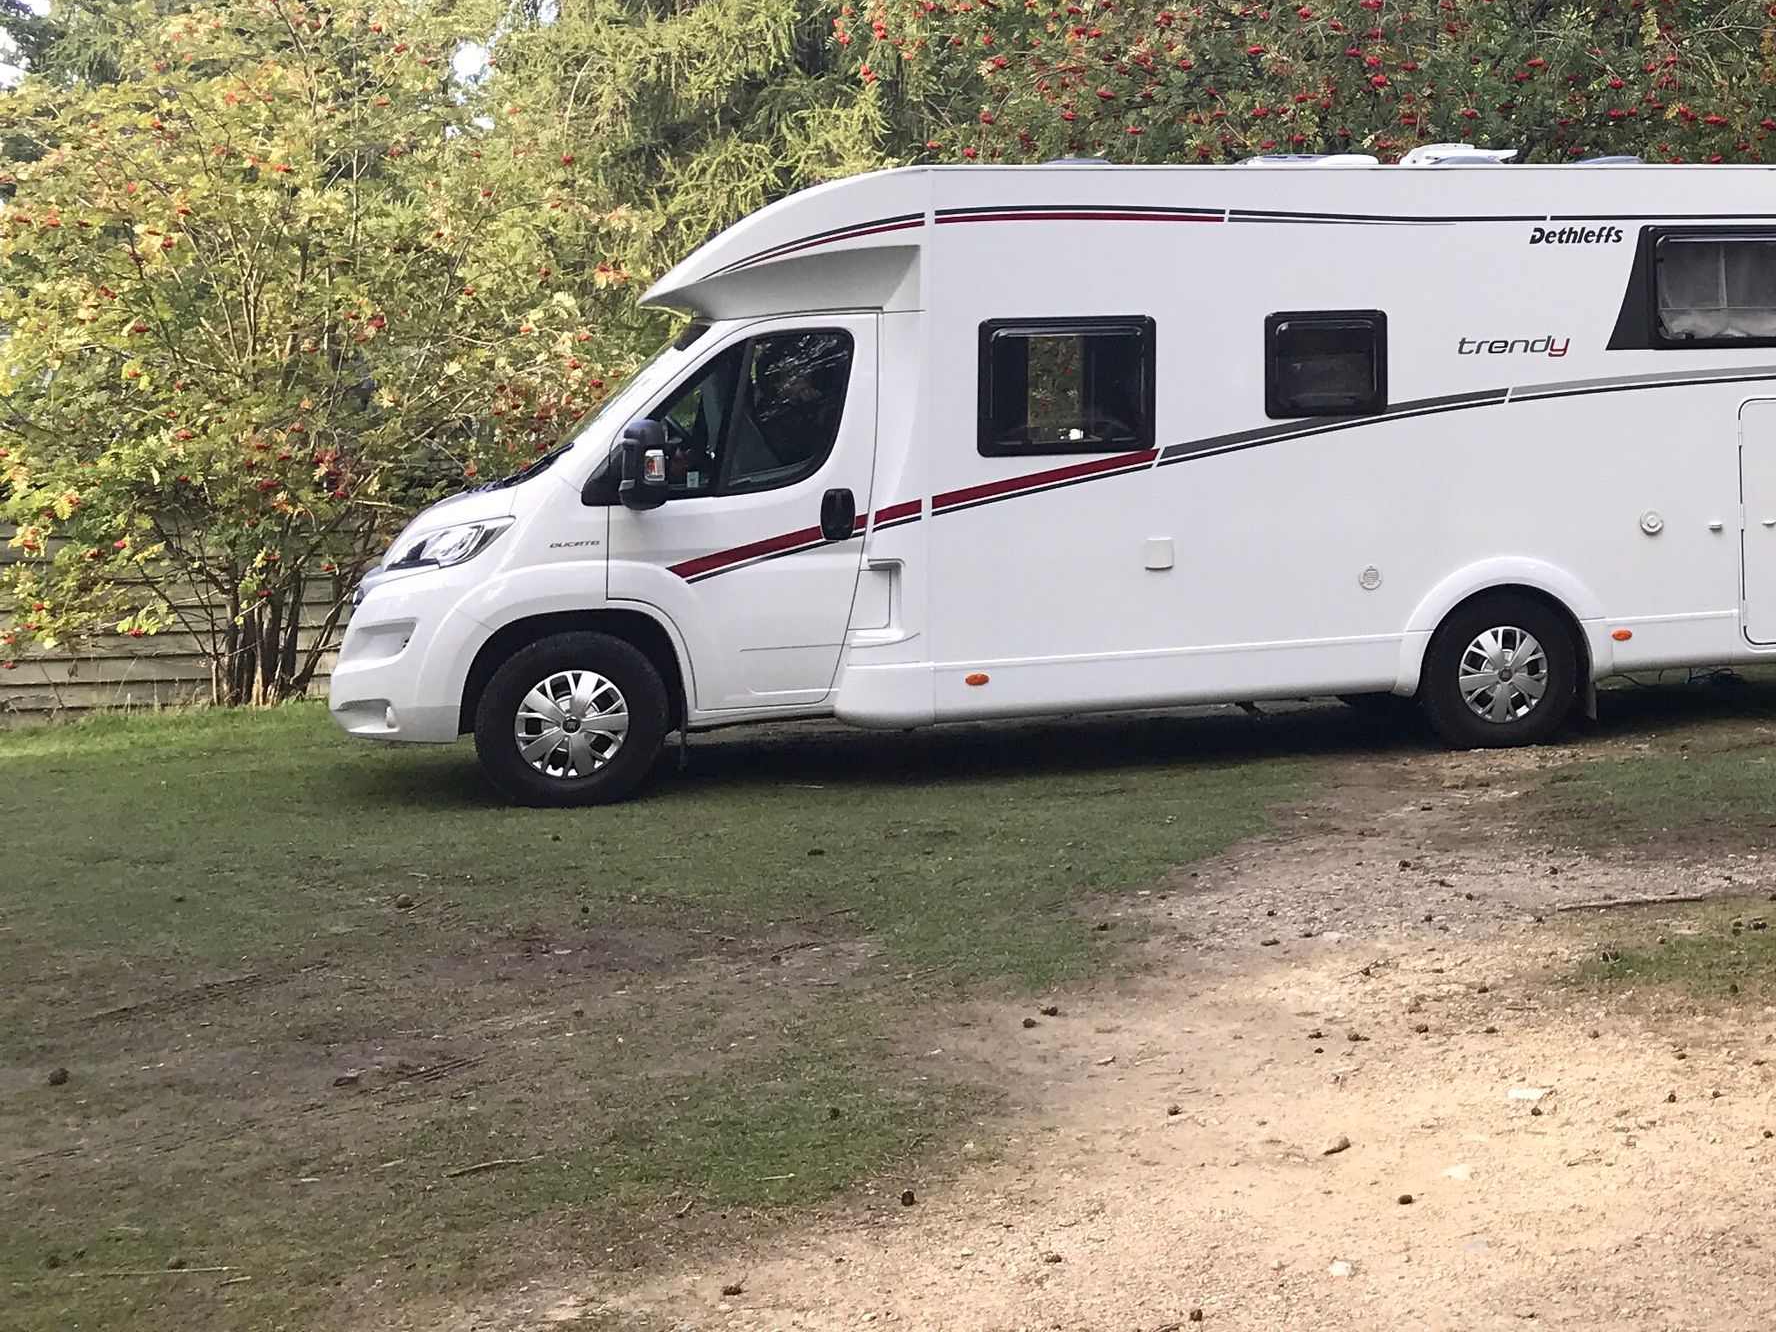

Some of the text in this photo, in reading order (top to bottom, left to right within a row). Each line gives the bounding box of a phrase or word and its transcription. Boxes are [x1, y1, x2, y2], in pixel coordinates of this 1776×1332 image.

[1529, 226, 1623, 244] Dethleffs
[1457, 335, 1570, 357] trendy
[549, 540, 600, 548] DUCATO
